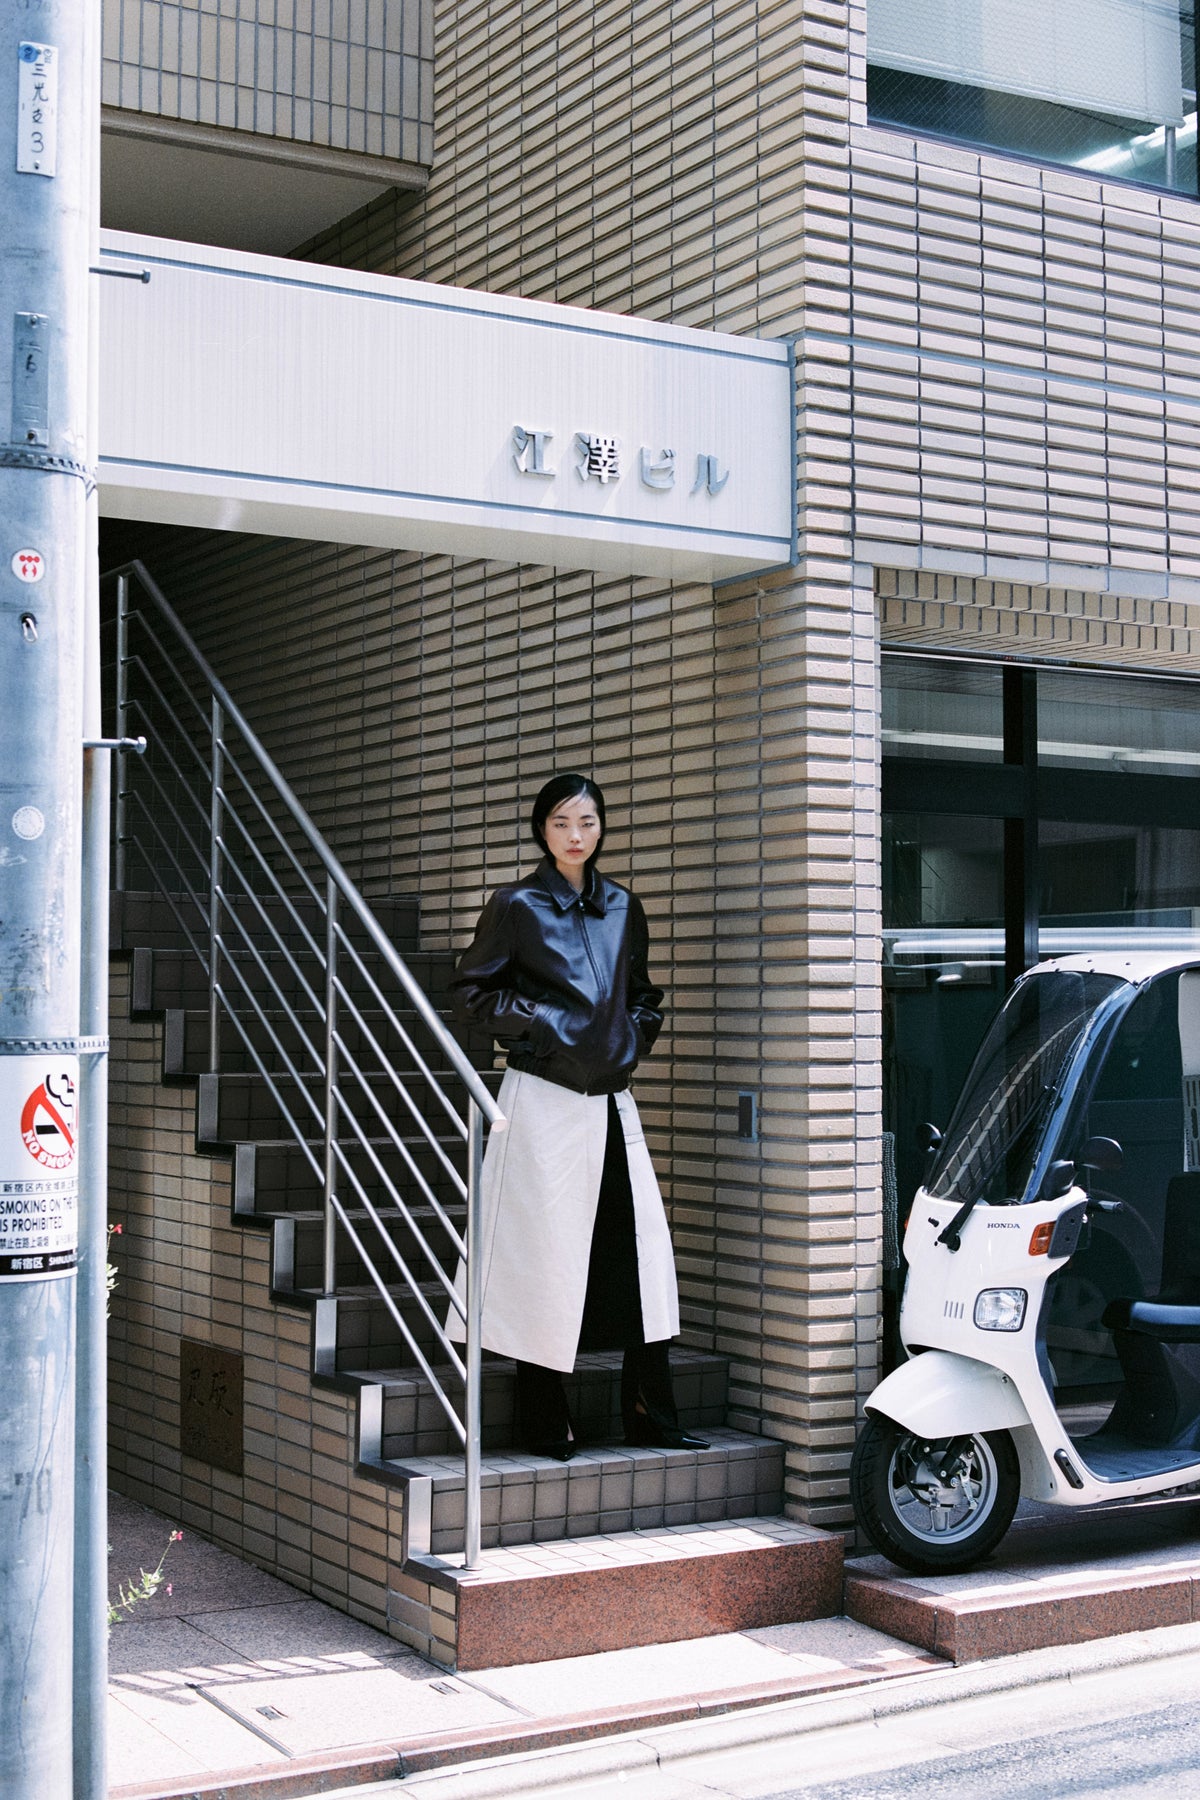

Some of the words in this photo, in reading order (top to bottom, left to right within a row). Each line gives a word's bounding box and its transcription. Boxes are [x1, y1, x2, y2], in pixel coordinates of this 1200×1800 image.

[513, 425, 730, 496] 江澤ビル
[22, 1129, 41, 1154] NO
[0, 1199, 47, 1215] SMOKING
[49, 1198, 61, 1212] ON
[0, 1219, 8, 1232] IS
[12, 1216, 62, 1232] PROHIBITED
[11, 1257, 44, 1270] 新宿区
